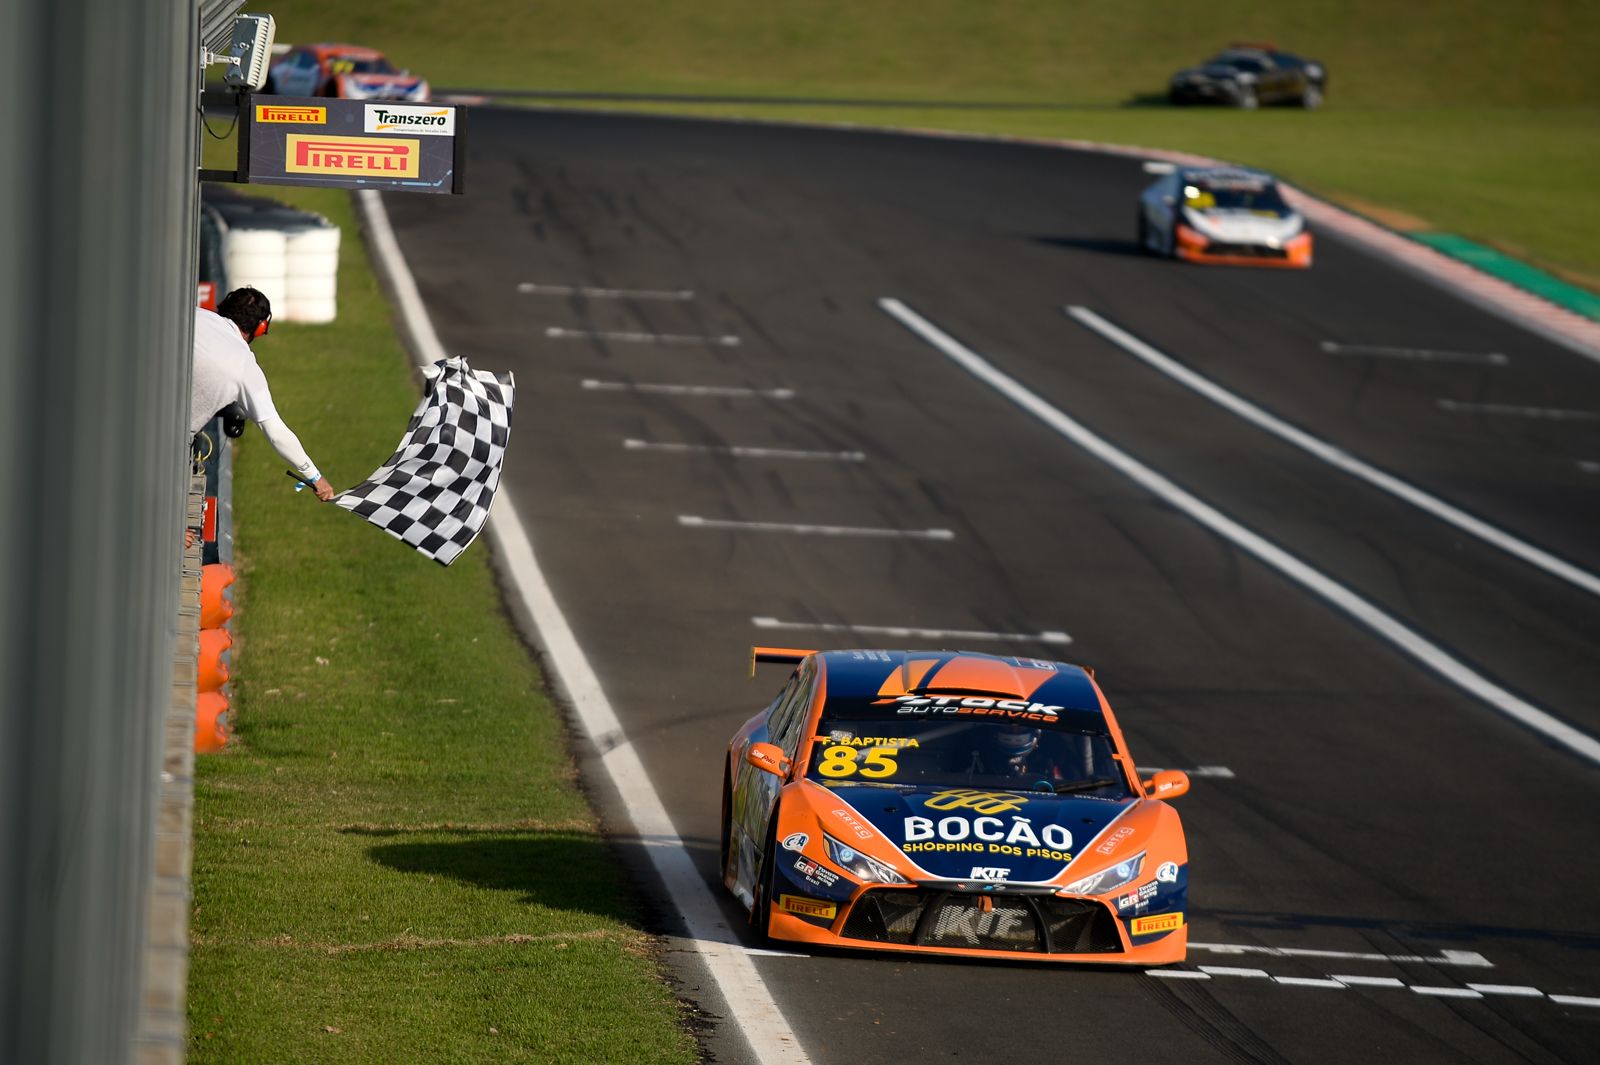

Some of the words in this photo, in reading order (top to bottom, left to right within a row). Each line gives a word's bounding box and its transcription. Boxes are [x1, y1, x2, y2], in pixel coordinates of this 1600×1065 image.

[262, 107, 320, 122] PIRELLI
[373, 109, 447, 126] Transzero
[295, 140, 410, 171] PIRELLI
[896, 695, 1065, 715] STOCK
[822, 736, 836, 745] F.
[840, 736, 920, 748] BAPTISTA
[818, 745, 899, 778] 85
[836, 809, 870, 838] ARTEC
[903, 815, 1073, 851] BOCÃO
[1101, 826, 1132, 853] ARTEC
[902, 841, 984, 853] SHOPPING
[988, 843, 1023, 856] DOS
[1026, 848, 1073, 862] PISOS
[796, 861, 814, 877] GR
[969, 866, 1012, 881] KTF
[785, 897, 831, 917] PIRELLI
[1119, 893, 1139, 909] GR
[1136, 914, 1178, 932] PIRELLI
